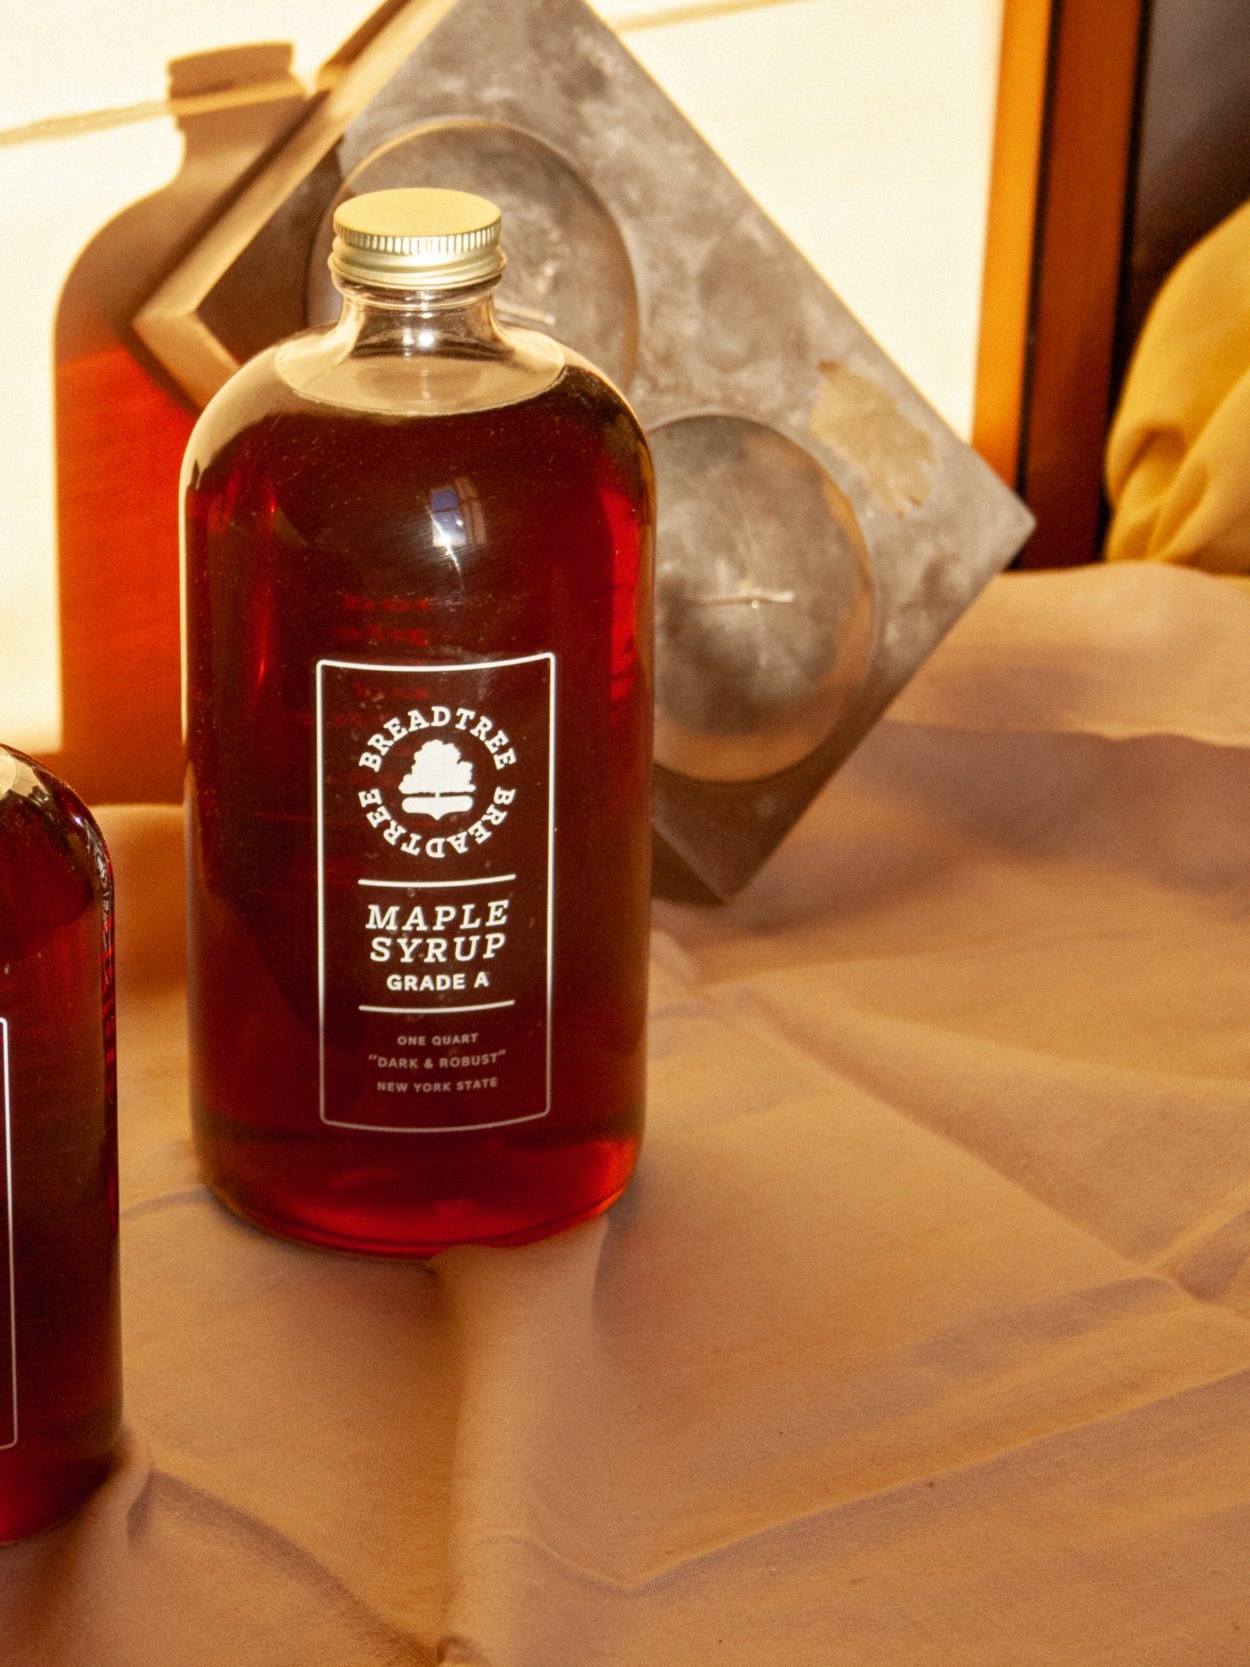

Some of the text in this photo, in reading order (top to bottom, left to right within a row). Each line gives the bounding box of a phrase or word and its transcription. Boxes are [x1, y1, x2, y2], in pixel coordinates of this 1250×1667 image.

[358, 705, 517, 773] BREADTREE
[358, 787, 516, 859] BREADTREE
[365, 899, 509, 932] MAPLE
[370, 932, 506, 963] SYRUP
[386, 971, 490, 991] GRADE A
[397, 1032, 479, 1046] ONE QUART
[423, 1057, 434, 1069] &
[377, 1076, 498, 1093] NEW YORK STATE
